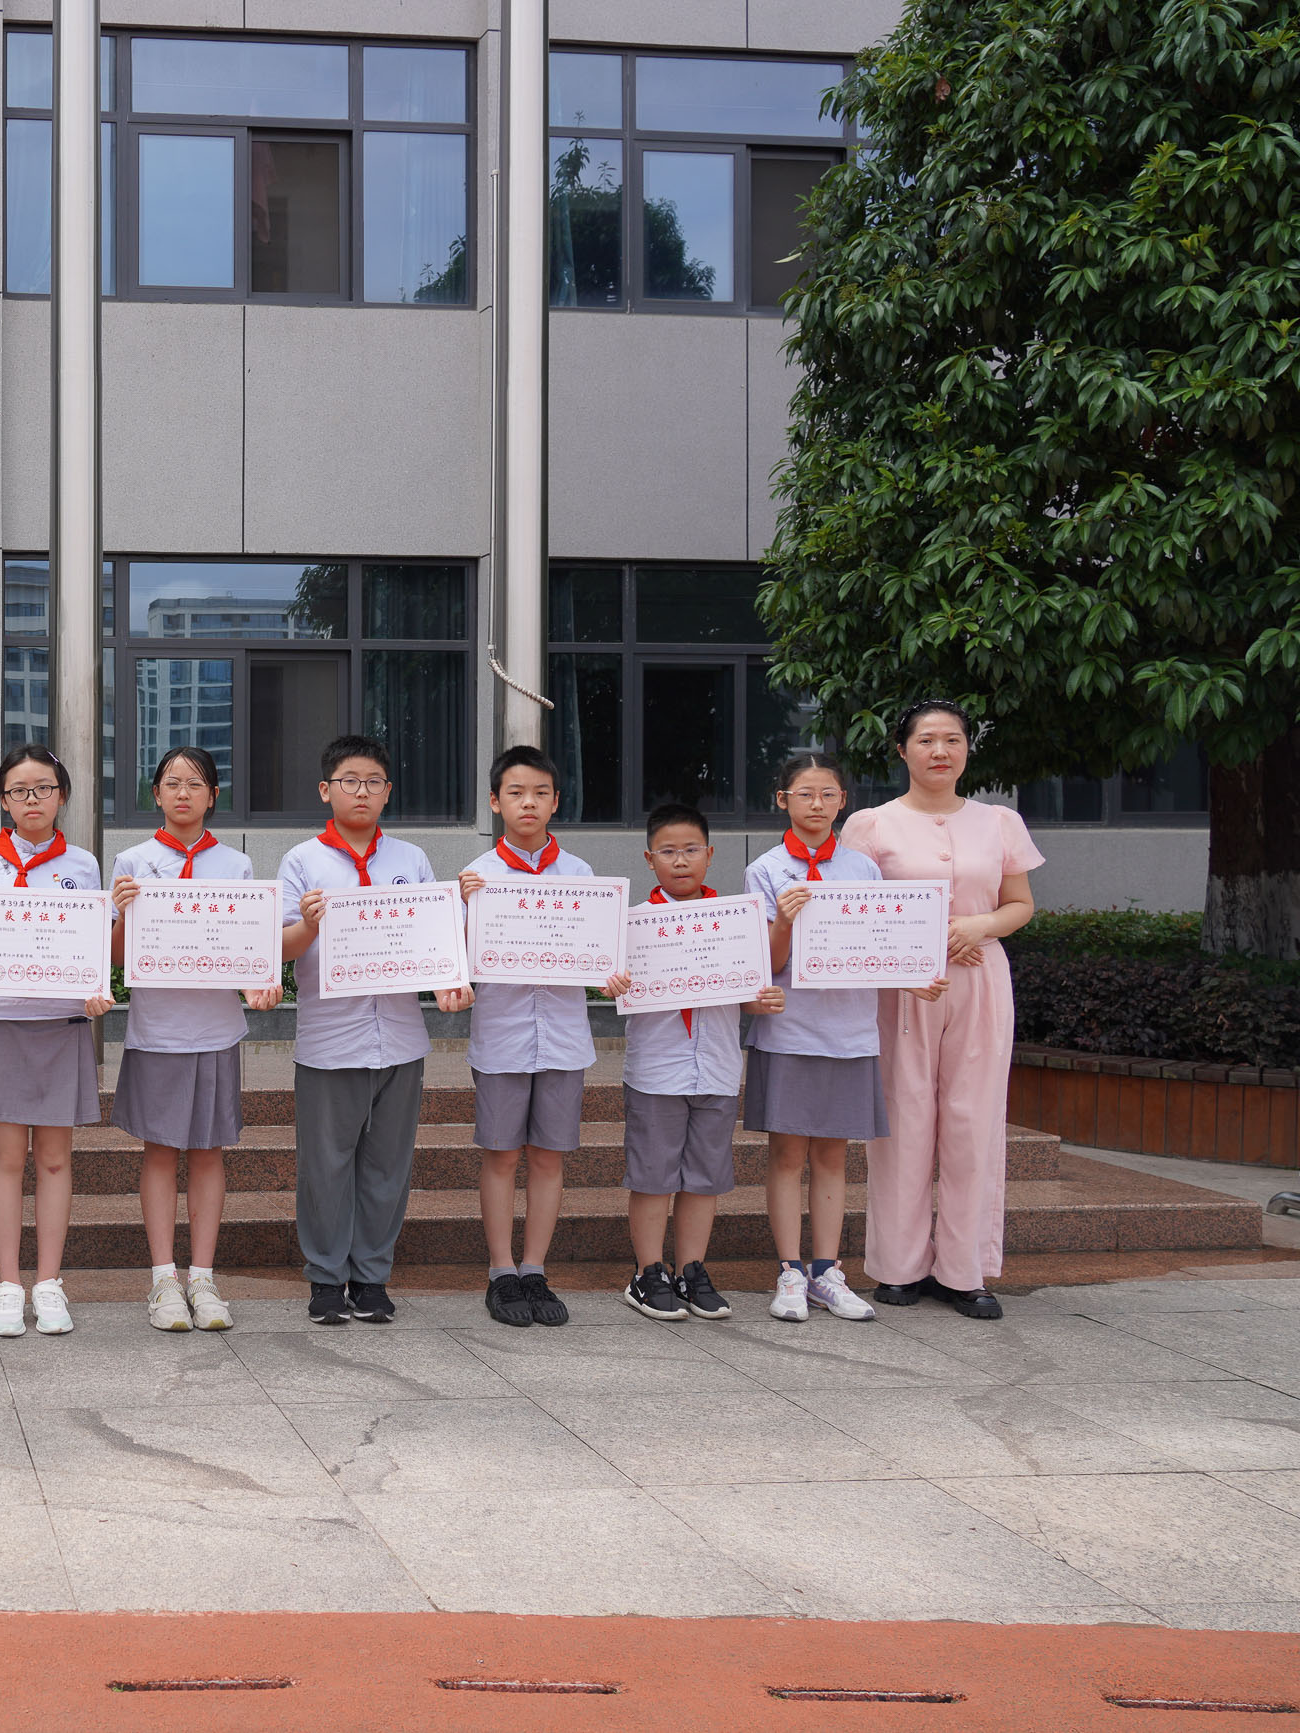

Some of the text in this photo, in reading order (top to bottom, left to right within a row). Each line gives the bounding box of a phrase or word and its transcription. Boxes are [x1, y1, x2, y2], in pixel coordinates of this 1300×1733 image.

[174, 902, 236, 914] 获奖证书
[518, 899, 581, 911] 获奖证书
[841, 904, 904, 914] 获奖证书
[5, 911, 67, 922] 获奖证书
[358, 908, 416, 921] 获奖证书
[658, 922, 721, 937] 获奖证书
